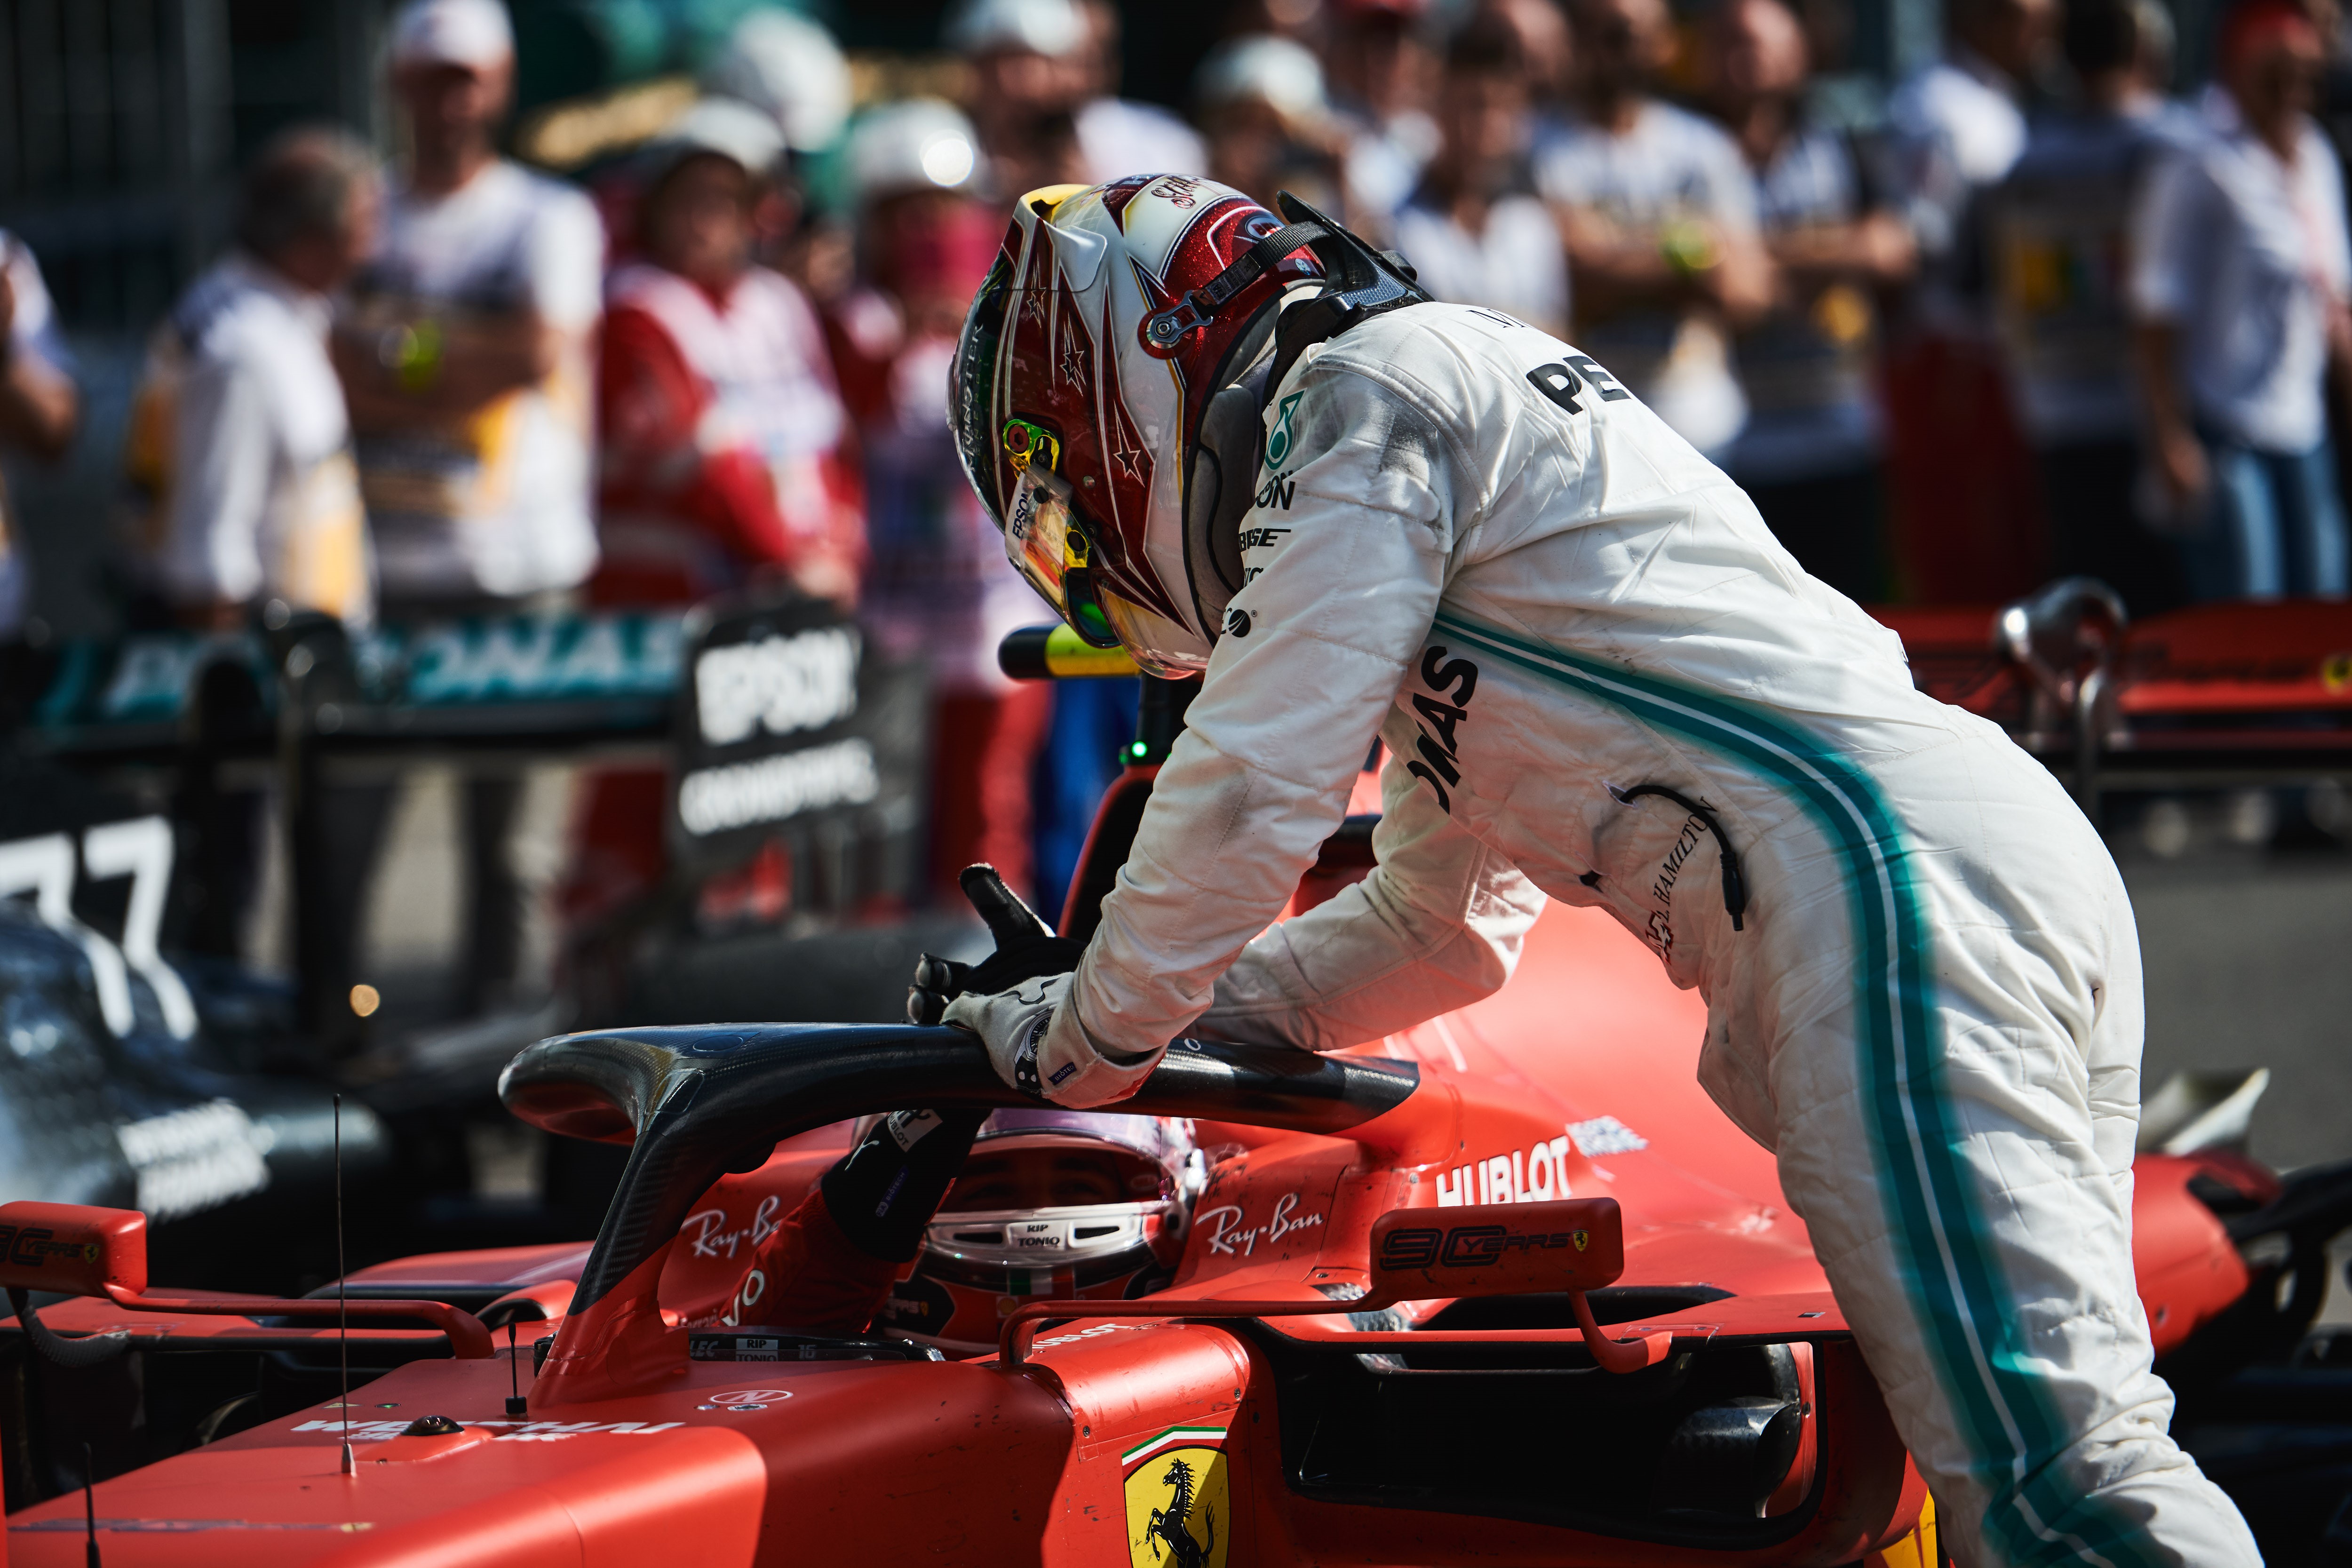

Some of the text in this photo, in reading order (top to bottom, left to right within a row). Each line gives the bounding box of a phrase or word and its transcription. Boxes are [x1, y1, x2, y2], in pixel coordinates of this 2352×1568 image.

[1526, 356, 1632, 415] PE
[1653, 796, 1718, 907] HAMILTON
[0, 814, 199, 1040] 77
[1436, 1135, 1572, 1207] HUBLOT
[1017, 1236, 1060, 1247] TONIO
[1026, 1224, 1049, 1233] RIP
[1379, 1225, 1572, 1271] 90 YEARS
[747, 1339, 767, 1349] RIP
[1032, 1323, 1132, 1349] UBLOT
[736, 1353, 776, 1361] TONIO
